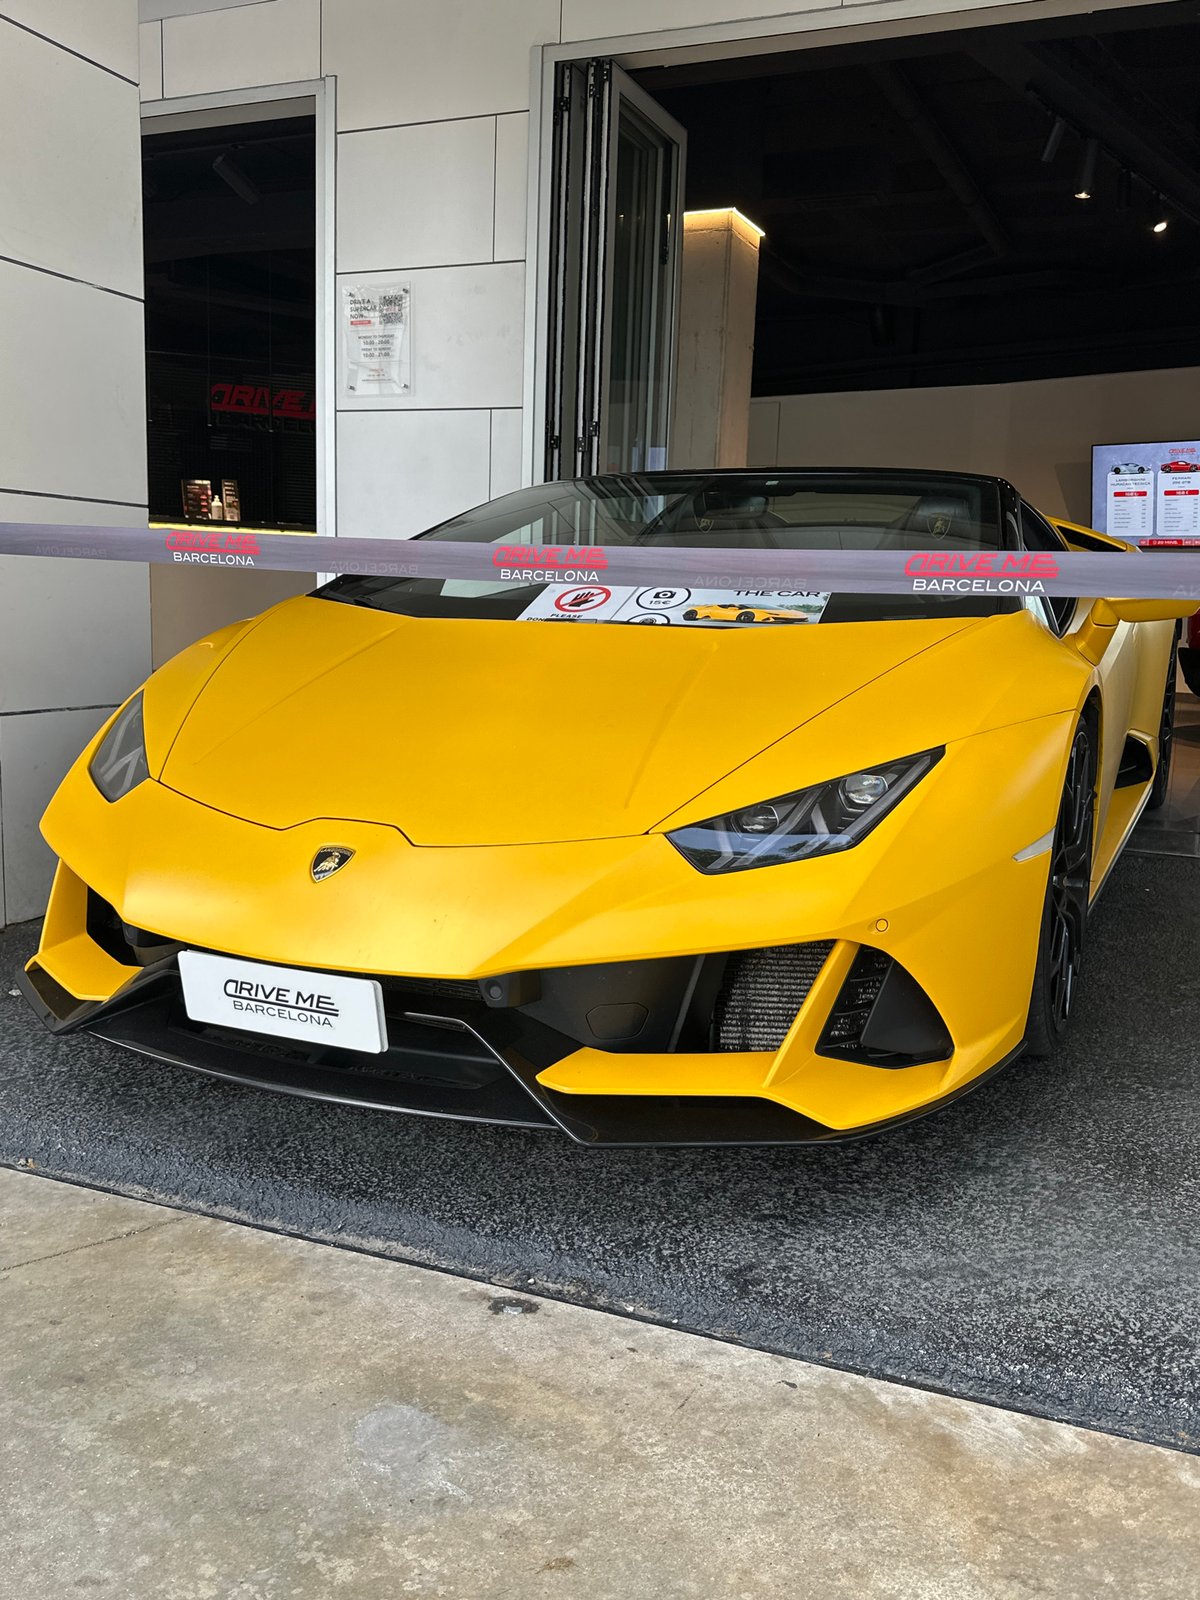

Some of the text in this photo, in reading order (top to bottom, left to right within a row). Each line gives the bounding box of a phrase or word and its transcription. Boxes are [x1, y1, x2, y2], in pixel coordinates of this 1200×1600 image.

[211, 383, 305, 416] DRIVE
[166, 531, 260, 553] DRIVE ME
[173, 551, 255, 566] BARCELONA
[492, 545, 609, 568] DRIVE ME
[904, 552, 1060, 578] DRIVE ME
[500, 568, 599, 582] BARCELONA
[912, 578, 1045, 593] BARCELONA
[776, 590, 821, 598] CAR
[223, 978, 339, 1013] DRIVE ME
[232, 1000, 333, 1028] BARCELONA
